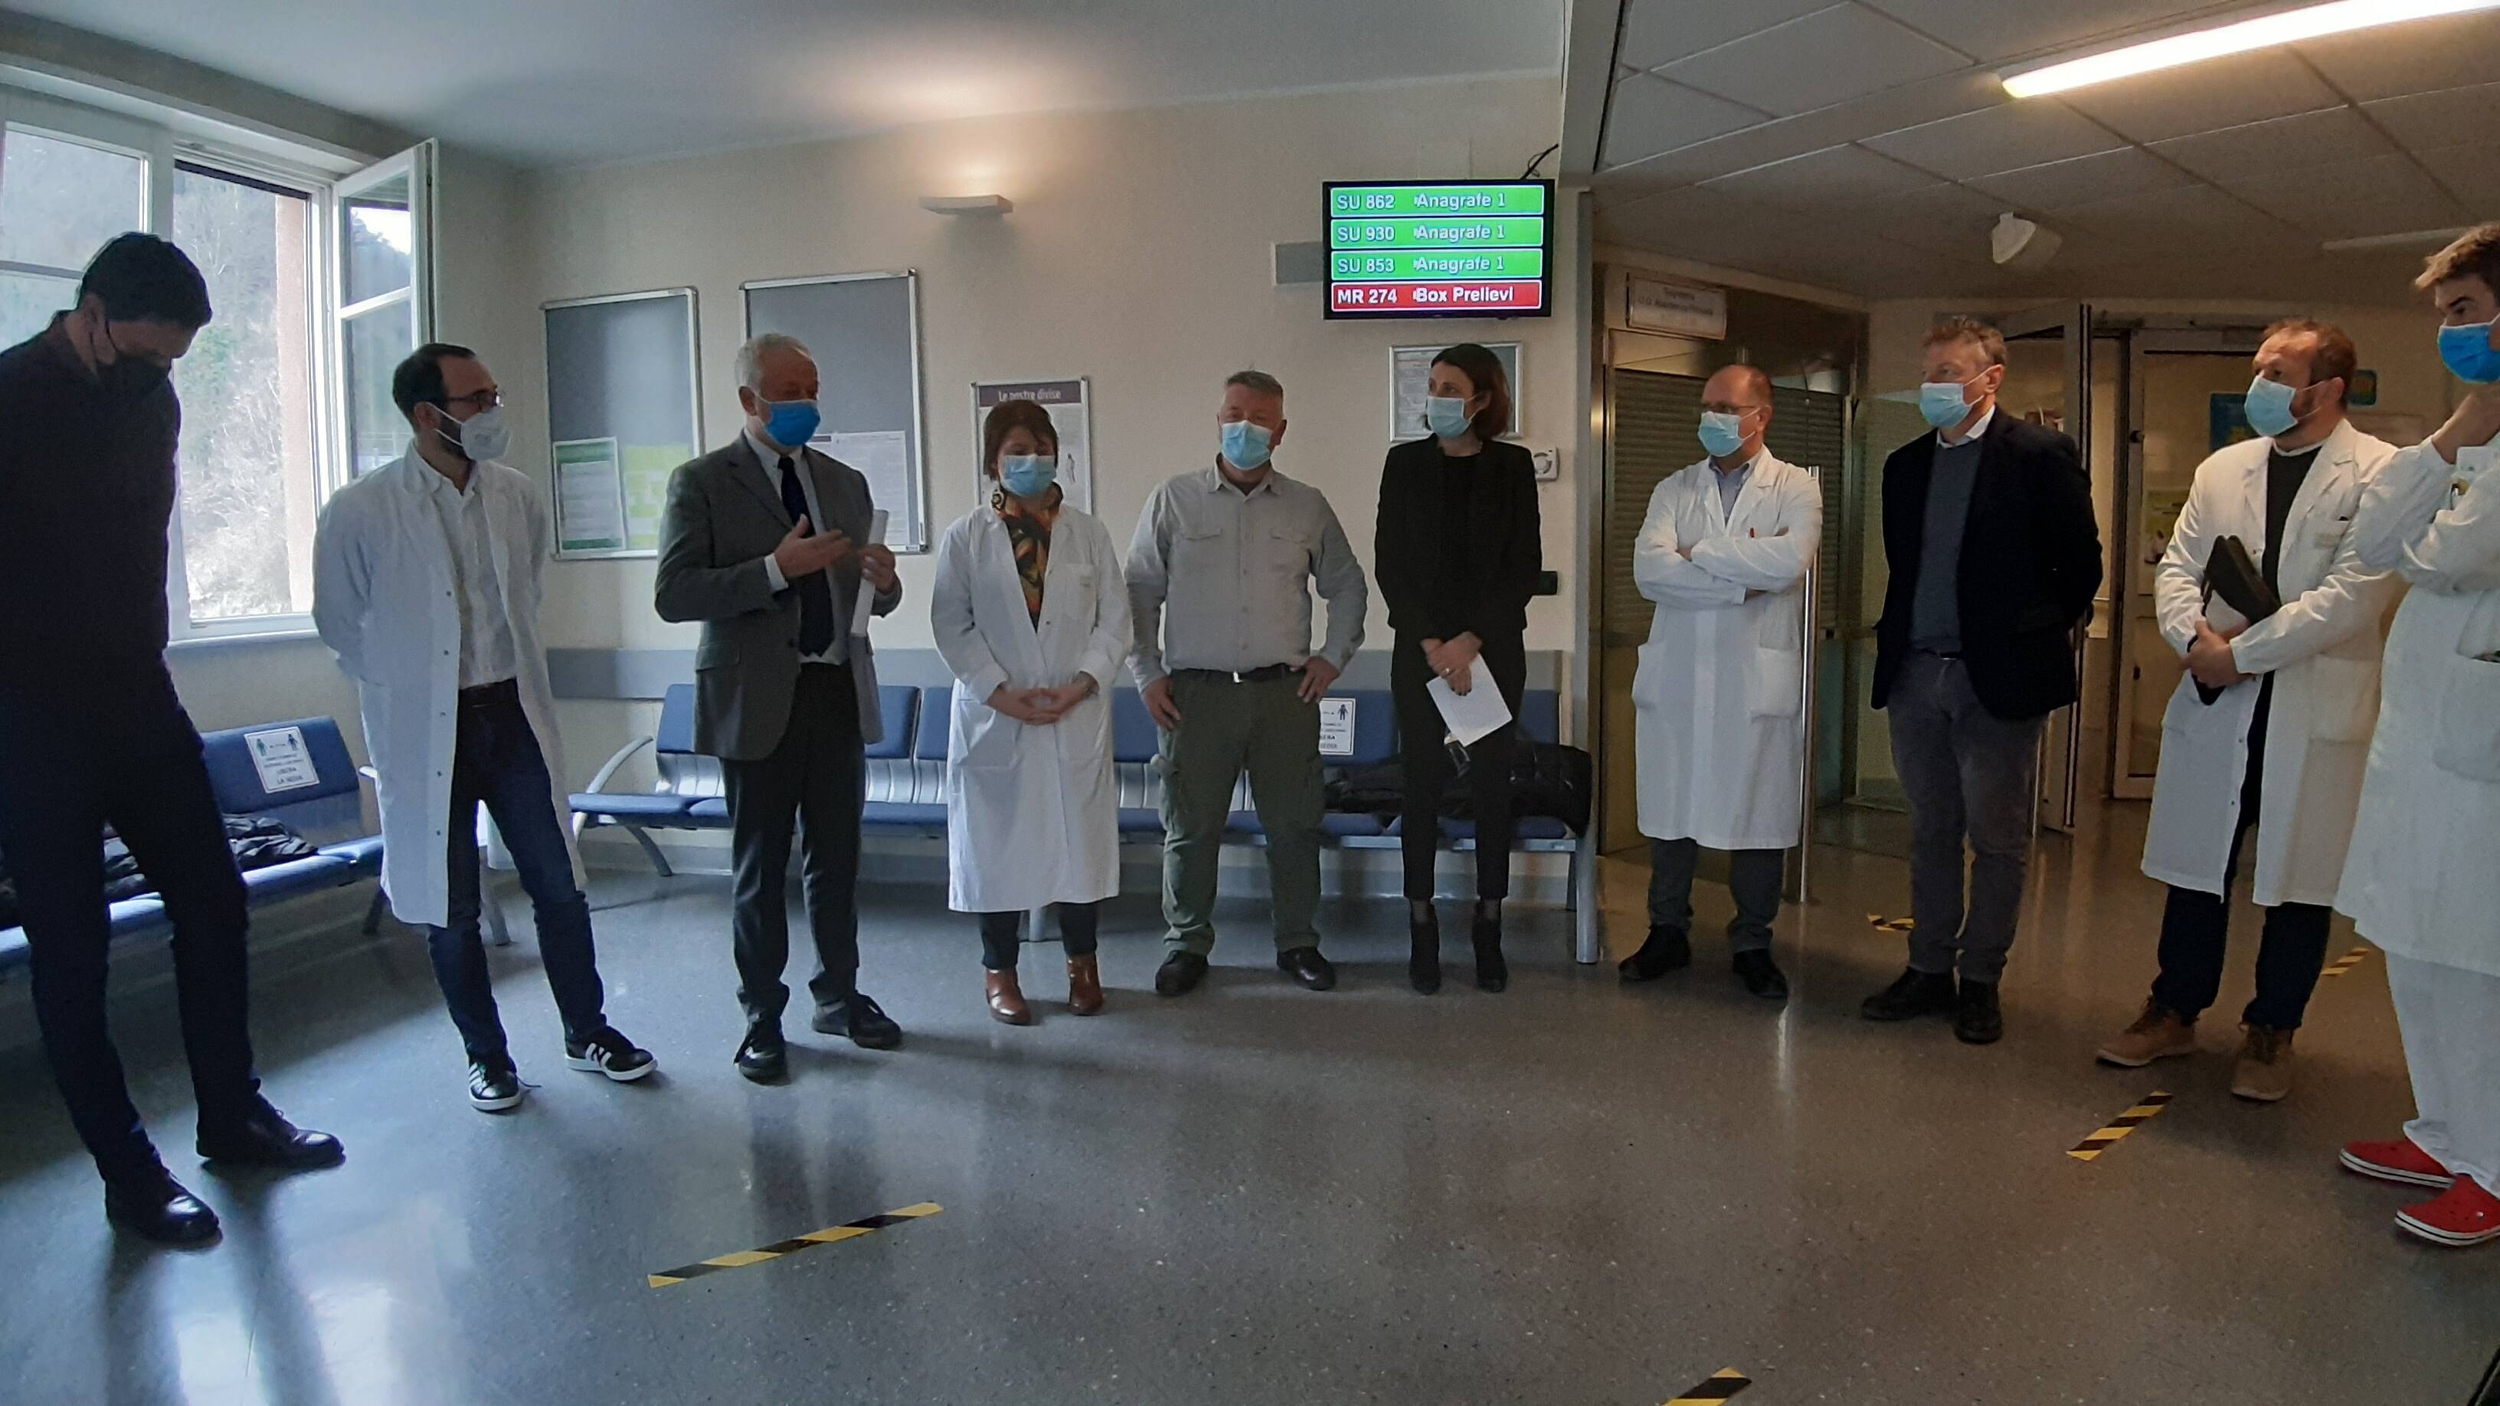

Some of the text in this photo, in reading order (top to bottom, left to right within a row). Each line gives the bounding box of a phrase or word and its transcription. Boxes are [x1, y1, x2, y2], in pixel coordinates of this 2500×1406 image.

[1337, 192, 1505, 211] SU 862 Anagrafe 1
[1337, 224, 1505, 243] SU 930 Anagrafe 1
[1337, 255, 1504, 274] SU 853 Anagrafe 1
[1337, 286, 1514, 304] MR 274 Box Prelievi
[998, 388, 1061, 402] Le nostre divise
